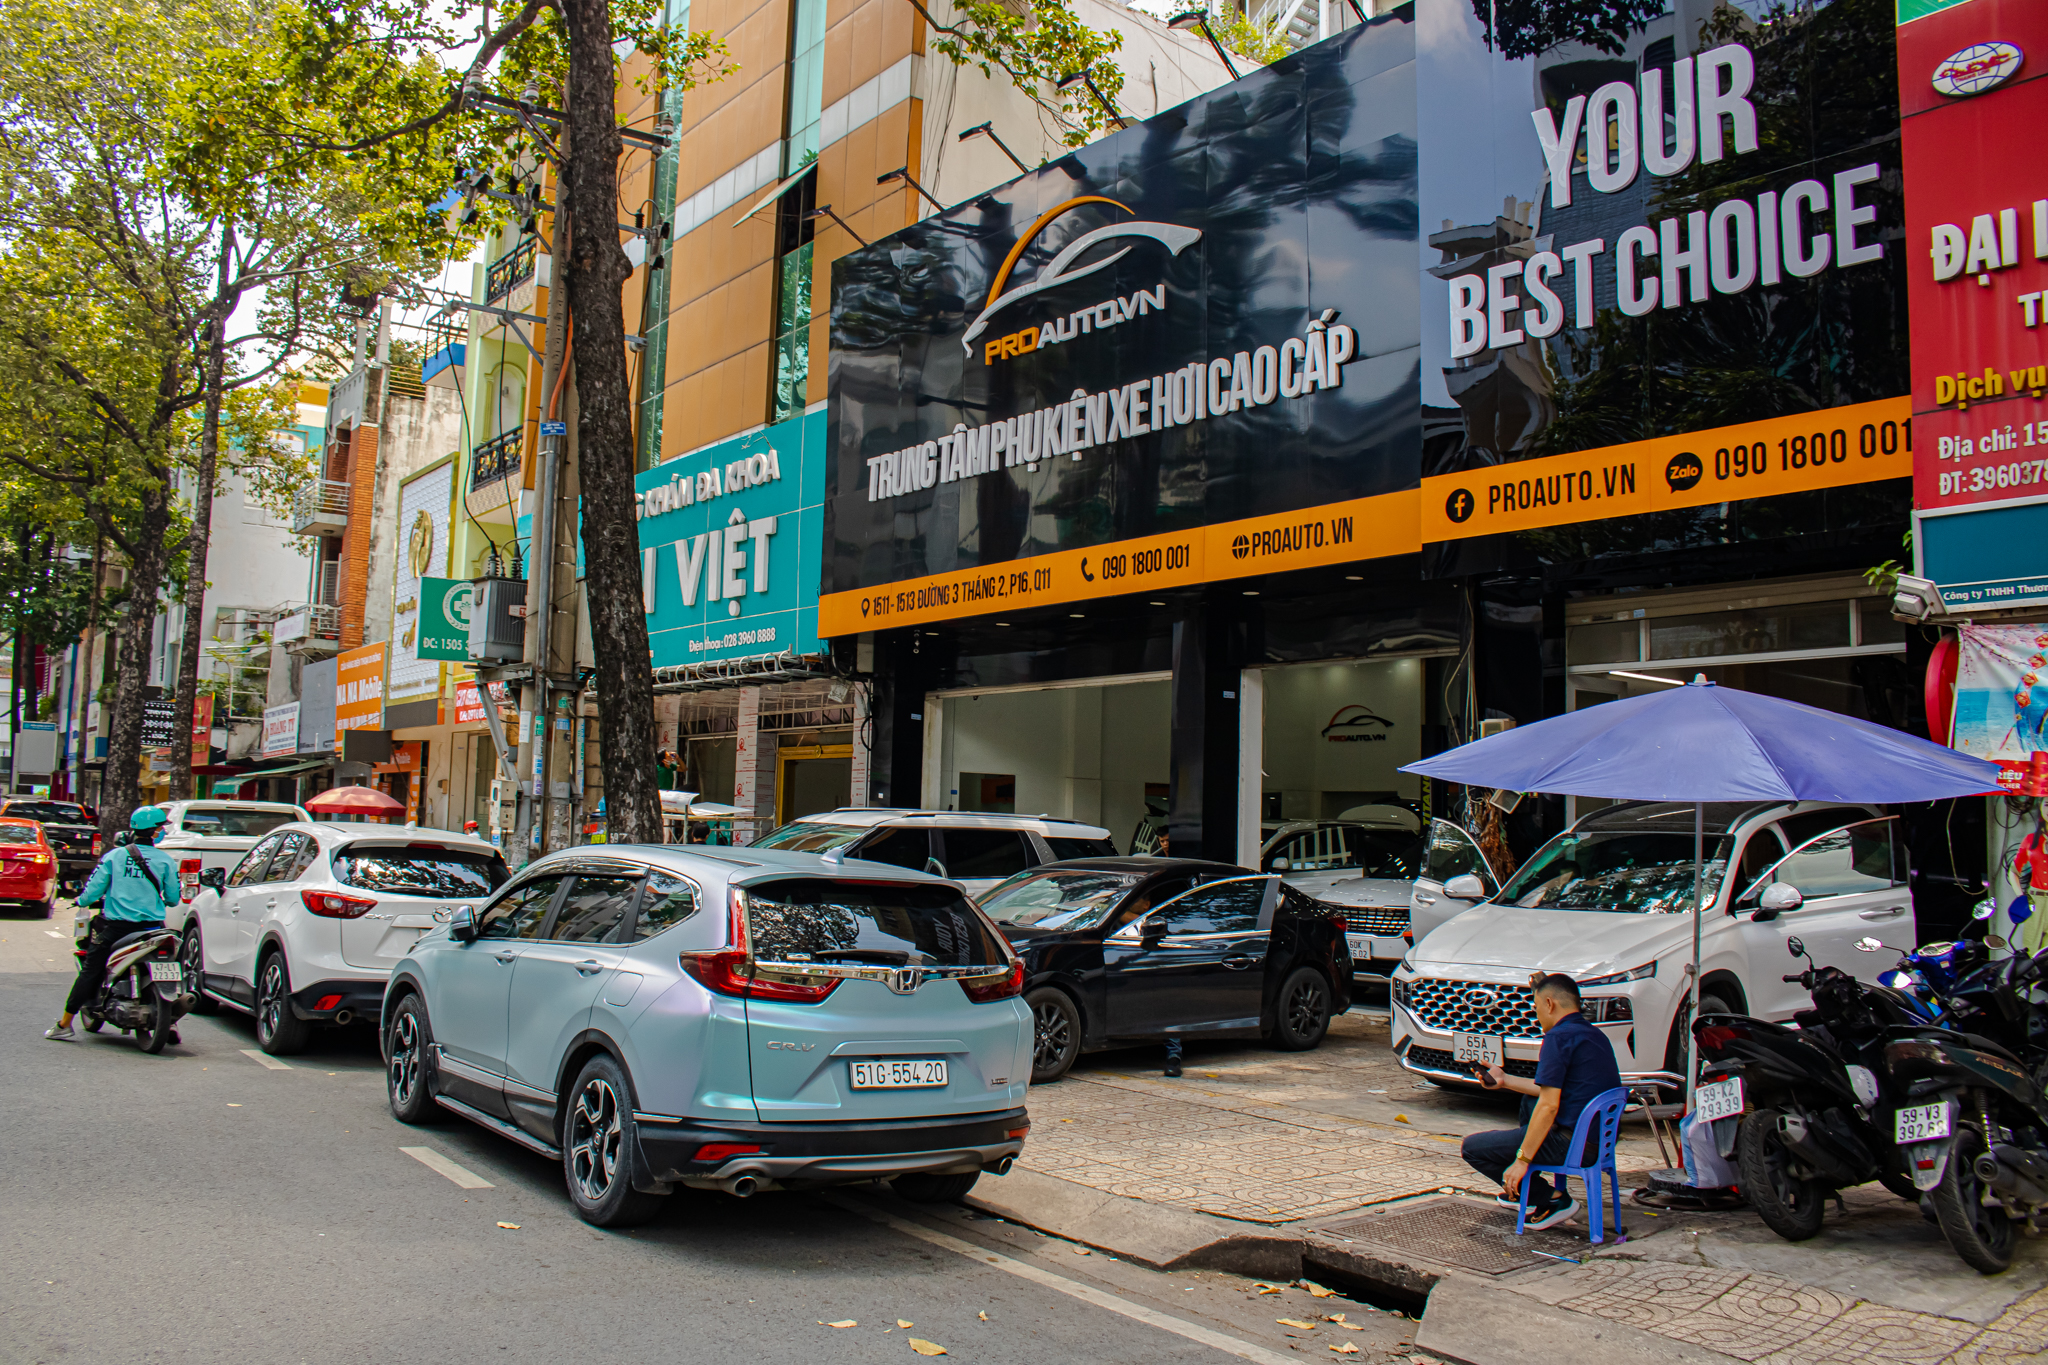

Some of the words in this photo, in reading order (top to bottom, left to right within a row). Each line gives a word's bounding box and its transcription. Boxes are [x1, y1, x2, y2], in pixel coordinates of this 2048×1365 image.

[1531, 43, 1759, 209] YOUR
[1448, 238, 1605, 359] BEST
[1615, 163, 1884, 318] CHOICE
[1930, 207, 2018, 286] ĐẠI
[984, 284, 1165, 366] PROAUTO.VN
[866, 441, 938, 502] TRUNG
[937, 423, 990, 484] TÂM
[989, 412, 1041, 473] PHỤ
[1040, 387, 1108, 462] KIỆN
[1107, 376, 1151, 444] XE
[1150, 361, 1207, 432] HƠI
[1206, 344, 1281, 418] CAO
[1280, 307, 1359, 400] CẤP
[1936, 372, 2003, 410] Dịch
[2009, 365, 2047, 398] vụ
[1669, 464, 1699, 480] Zalo
[1715, 442, 1767, 481] 090
[1777, 428, 1847, 472] 1800
[1859, 419, 1912, 459] 001
[1938, 435, 1974, 463] Địa
[1979, 425, 2018, 454] chỉ:
[644, 473, 694, 518] KHÁM
[696, 467, 722, 502] ĐA
[724, 449, 781, 494] KHOA
[1489, 463, 1636, 515] PROAUTO.VN
[674, 507, 778, 617] VIỆT
[1102, 554, 1127, 580] 090
[1131, 548, 1162, 576] 1800
[1166, 543, 1190, 570] 001
[917, 582, 950, 610] ĐƯỜNG
[952, 583, 960, 604] 3
[962, 575, 996, 603] THÁNG
[998, 575, 1009, 599] 2,
[1034, 567, 1051, 592] Q11
[1943, 590, 1970, 603] Công
[1971, 588, 1983, 601] ty
[1985, 586, 2015, 597] TNHH
[422, 637, 438, 649] ĐC:
[441, 638, 462, 651] 1505
[689, 639, 704, 655] Điện
[724, 632, 737, 648] 028
[738, 629, 757, 646] 3960
[757, 627, 776, 643] 8888
[337, 683, 346, 706] NA
[348, 681, 357, 704] NA
[359, 675, 382, 702] Mobile
[1328, 734, 1387, 742] PROAUTO.VN
[766, 1040, 816, 1052] CR-V
[1466, 1035, 1488, 1050] 65A
[855, 1062, 945, 1086] 51G-554.20
[1703, 1081, 1735, 1103] 59-K2
[1700, 1096, 1740, 1120] 293.39
[1902, 1105, 1940, 1124] 59-V3
